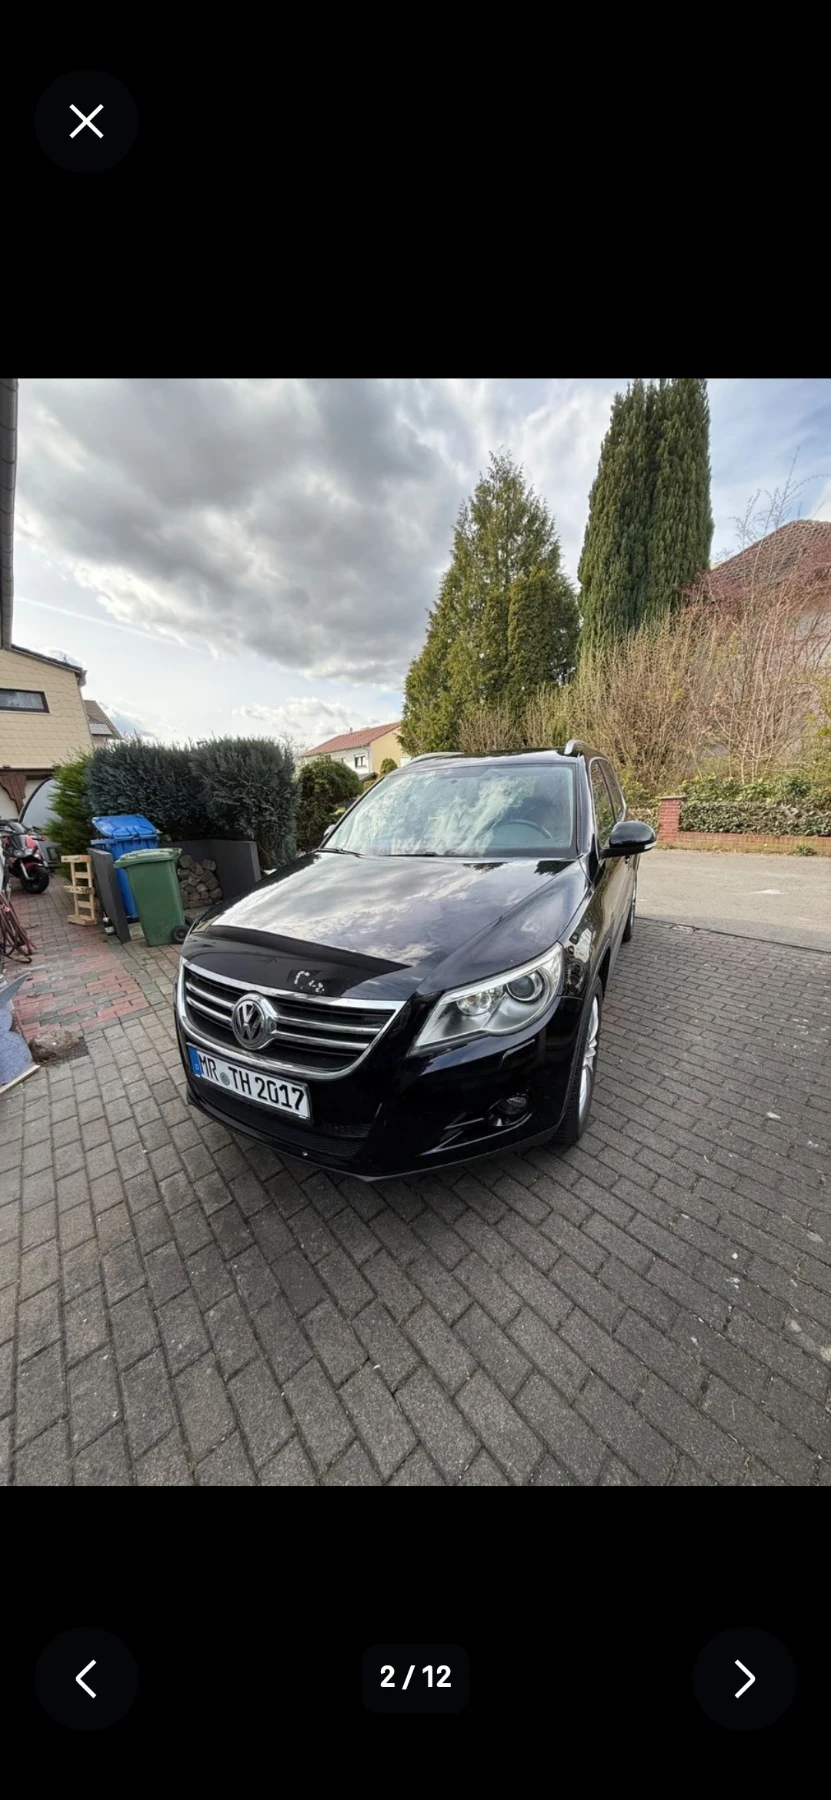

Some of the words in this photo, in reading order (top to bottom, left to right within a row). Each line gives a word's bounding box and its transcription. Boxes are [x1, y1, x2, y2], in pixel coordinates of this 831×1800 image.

[235, 999, 265, 1045] VW
[198, 1054, 219, 1082] MR
[228, 1066, 252, 1095] TH
[255, 1076, 305, 1111] 2017
